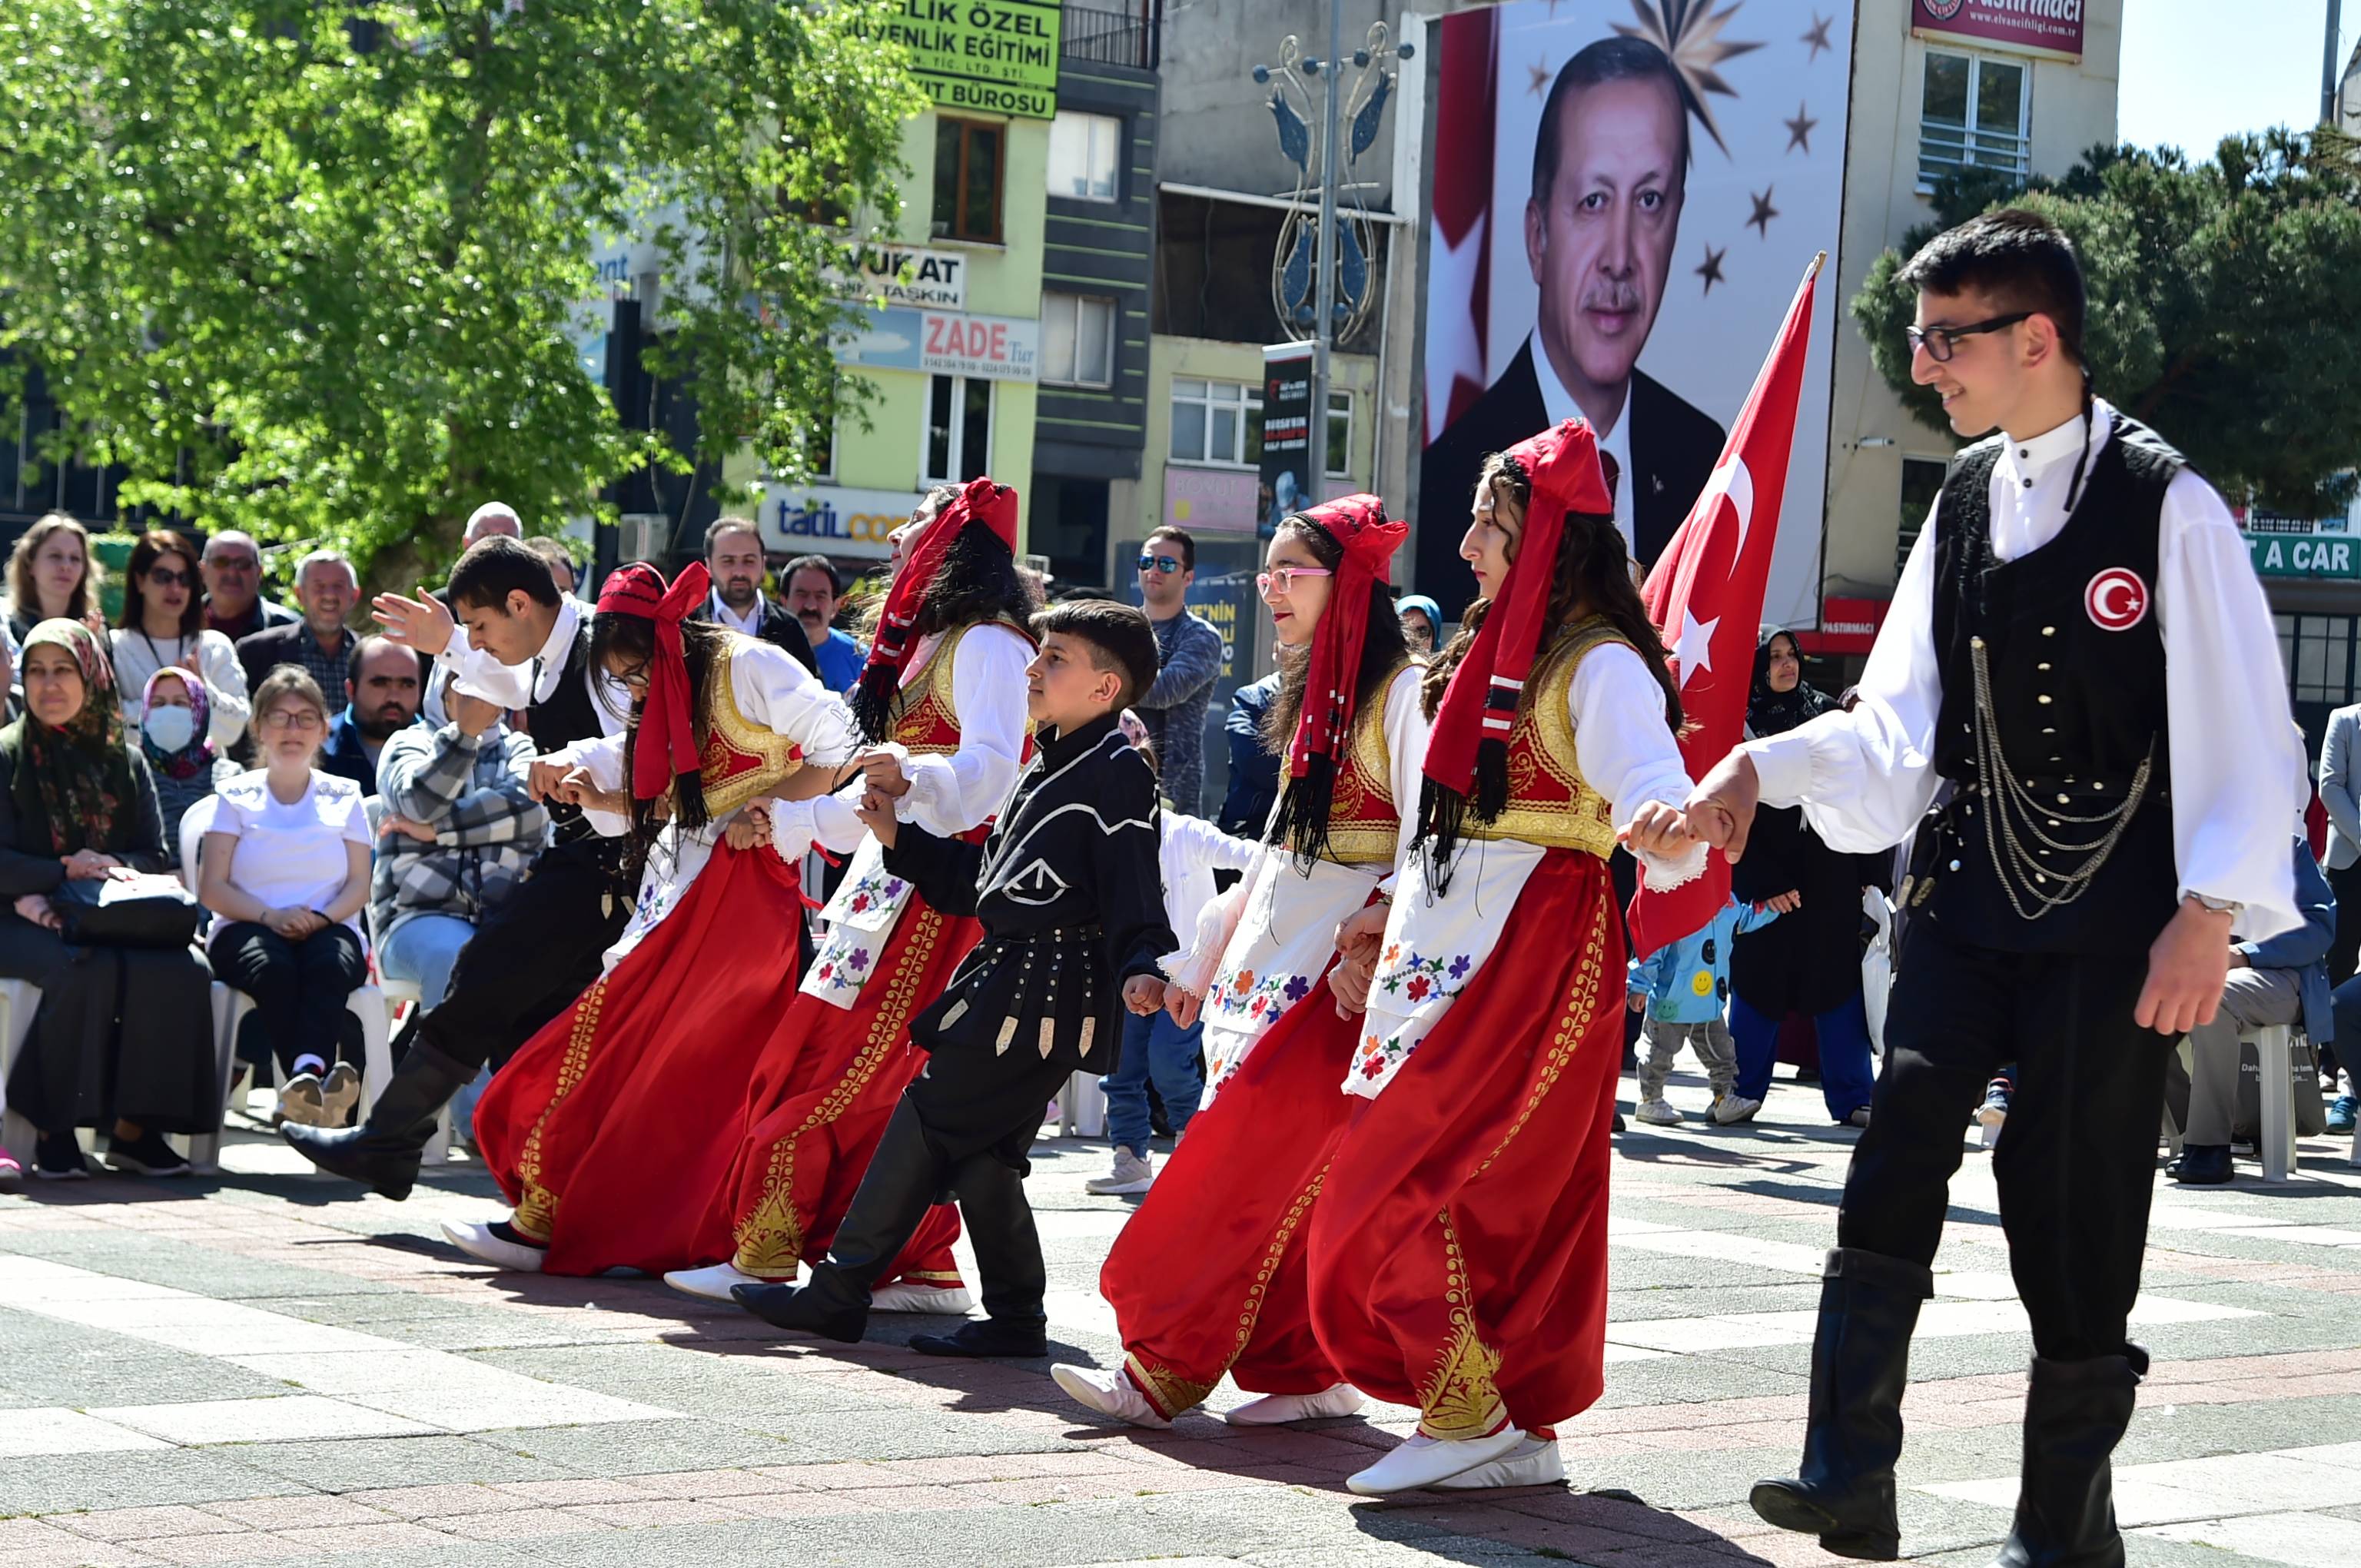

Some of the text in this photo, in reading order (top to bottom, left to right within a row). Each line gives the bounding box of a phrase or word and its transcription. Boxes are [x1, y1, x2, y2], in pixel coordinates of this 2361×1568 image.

[968, 2, 1051, 38] ÖZEL
[1970, 11, 2078, 38] www.elvanciftligi.com.tr
[964, 32, 1051, 68] EĞİTİMİ
[952, 82, 1047, 114] BÜROSU
[879, 283, 958, 304] TAŞKIN
[925, 317, 1034, 363] ZADE Tur
[2263, 540, 2284, 570] A
[2293, 540, 2350, 572] CAR
